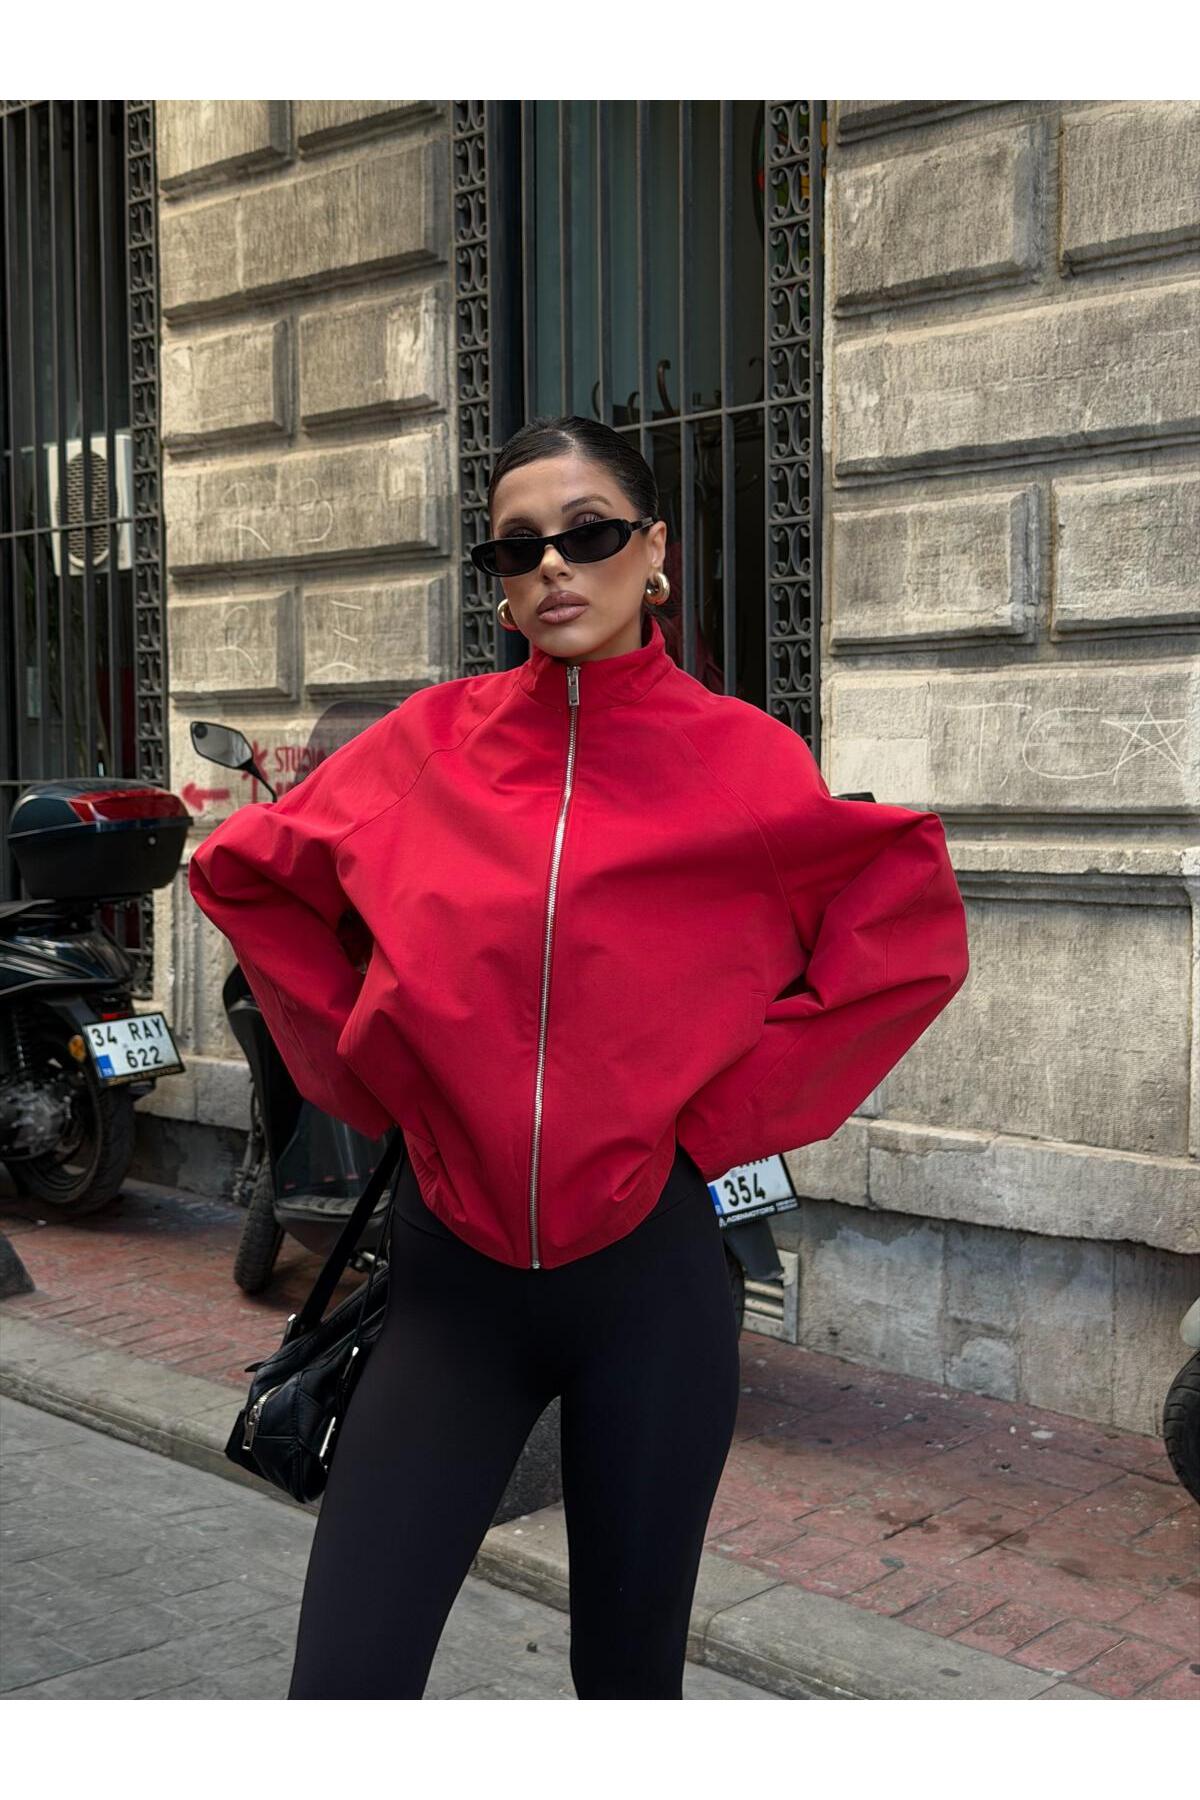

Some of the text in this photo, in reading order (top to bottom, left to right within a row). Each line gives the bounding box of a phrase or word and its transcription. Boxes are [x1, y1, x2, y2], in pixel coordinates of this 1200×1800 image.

[91, 1017, 164, 1048] 34 RAY
[126, 1046, 164, 1068] 622
[723, 1172, 767, 1207] 354
